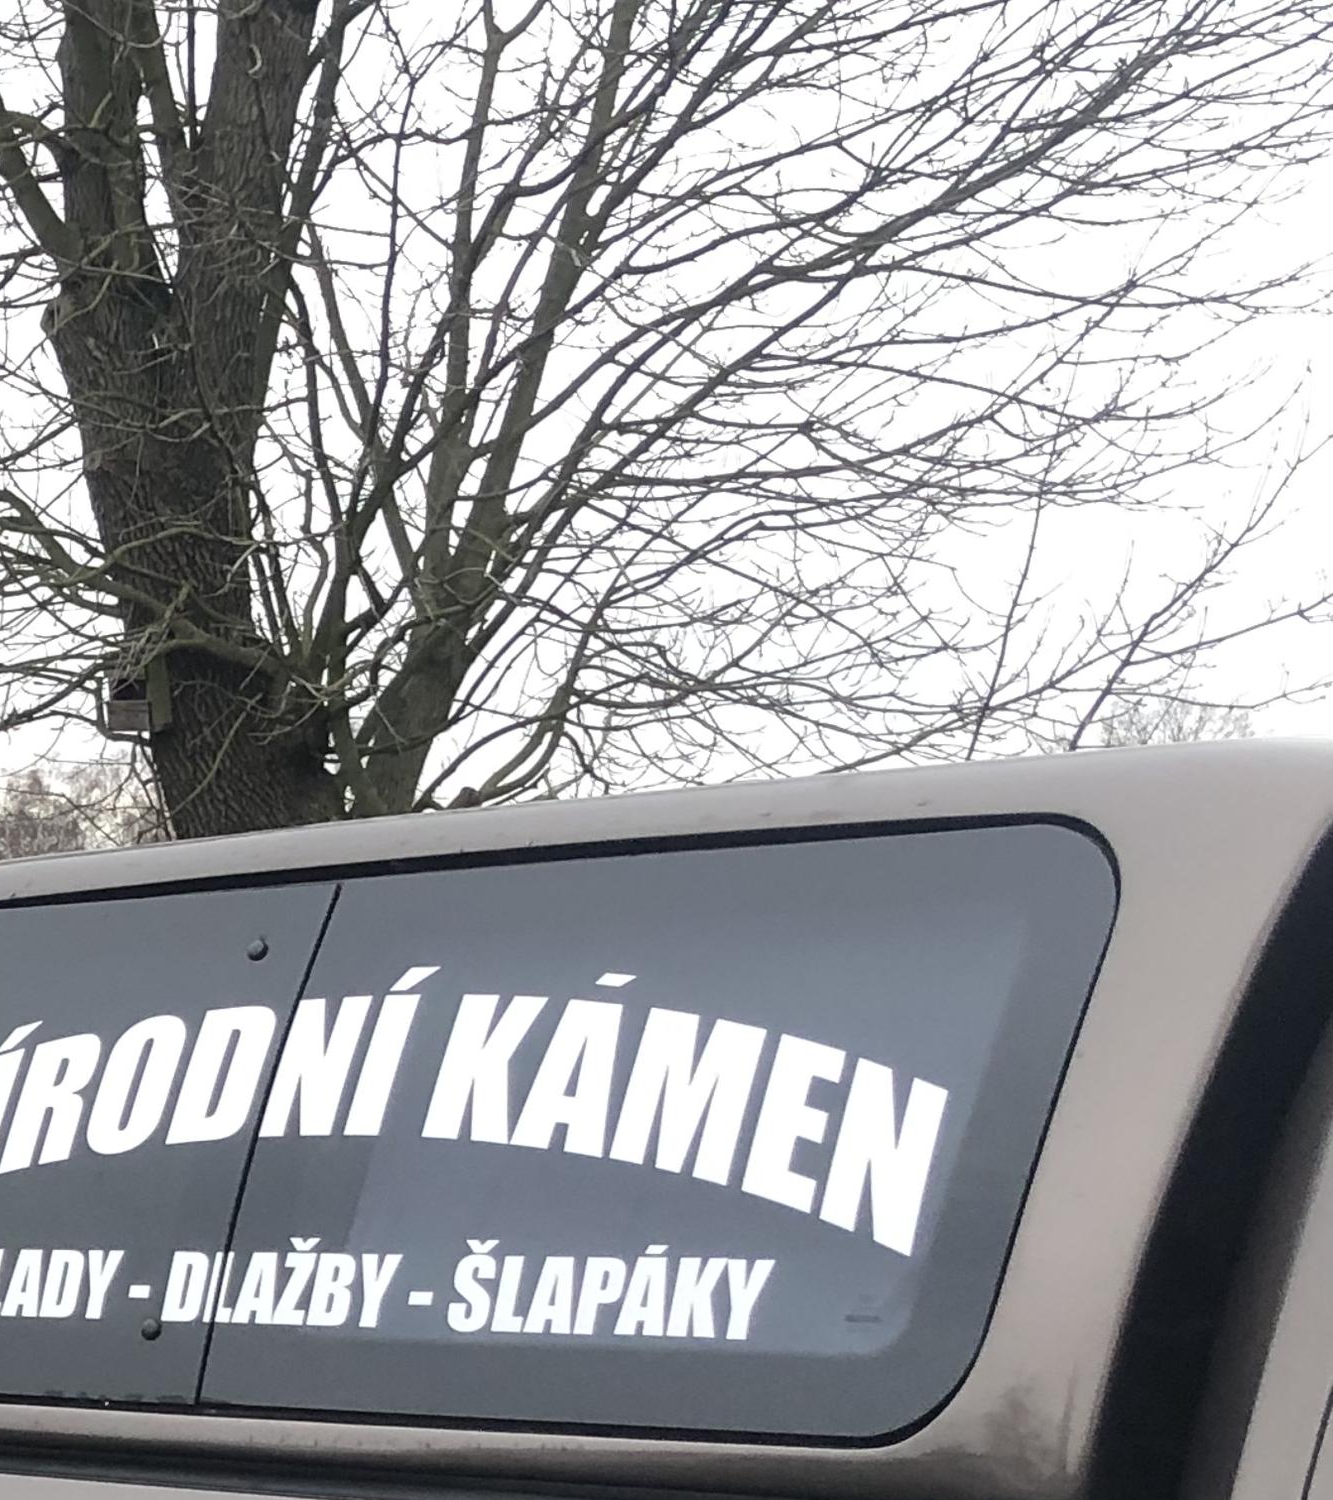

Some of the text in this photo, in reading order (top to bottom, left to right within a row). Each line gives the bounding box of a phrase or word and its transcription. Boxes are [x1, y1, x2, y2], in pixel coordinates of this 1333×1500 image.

[421, 972, 950, 1258] KÁMEN
[160, 1237, 404, 1329] DLAŽBY
[446, 1239, 776, 1341] ŠLAPÁKY
